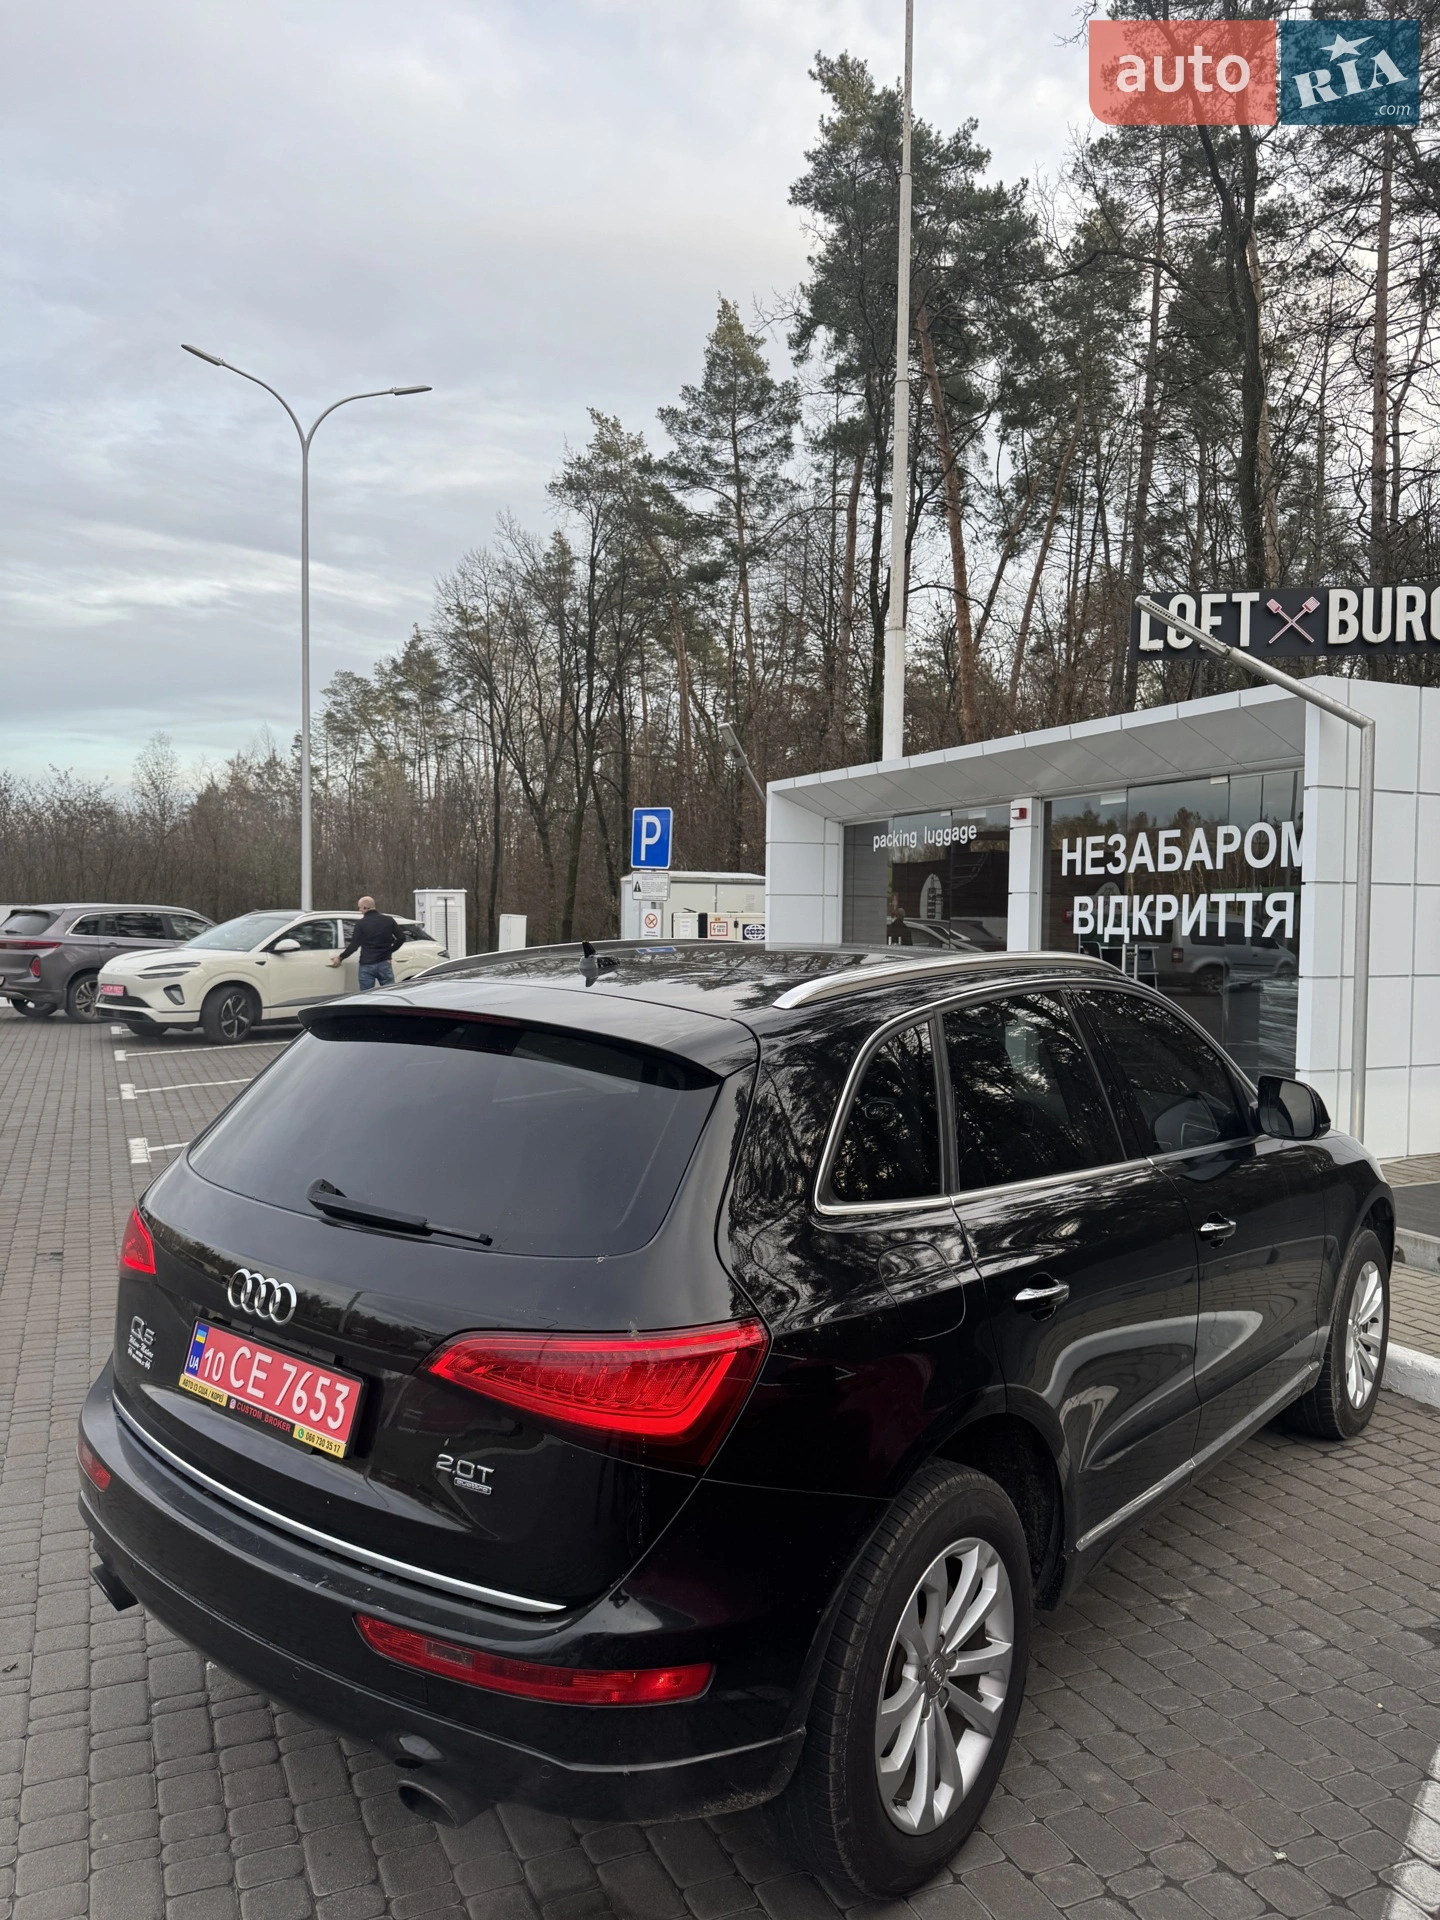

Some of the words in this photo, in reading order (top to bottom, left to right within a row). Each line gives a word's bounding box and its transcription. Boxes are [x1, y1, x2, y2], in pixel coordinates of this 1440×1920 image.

[1139, 592, 1260, 651] LOFT
[640, 815, 662, 861] P
[873, 830, 917, 851] packing
[924, 825, 977, 847] luggage
[1061, 821, 1303, 877] НЕЗАБАРОМ
[1073, 892, 1295, 943] ВІДКРИТТЯ
[131, 1315, 156, 1346] Q5
[188, 1354, 199, 1371] UA
[204, 1347, 226, 1382] 10
[229, 1346, 273, 1399] CE
[275, 1362, 351, 1431] 7653
[236, 1402, 291, 1432] CUSTOM_BROKER
[436, 1453, 495, 1484] 2.0T
